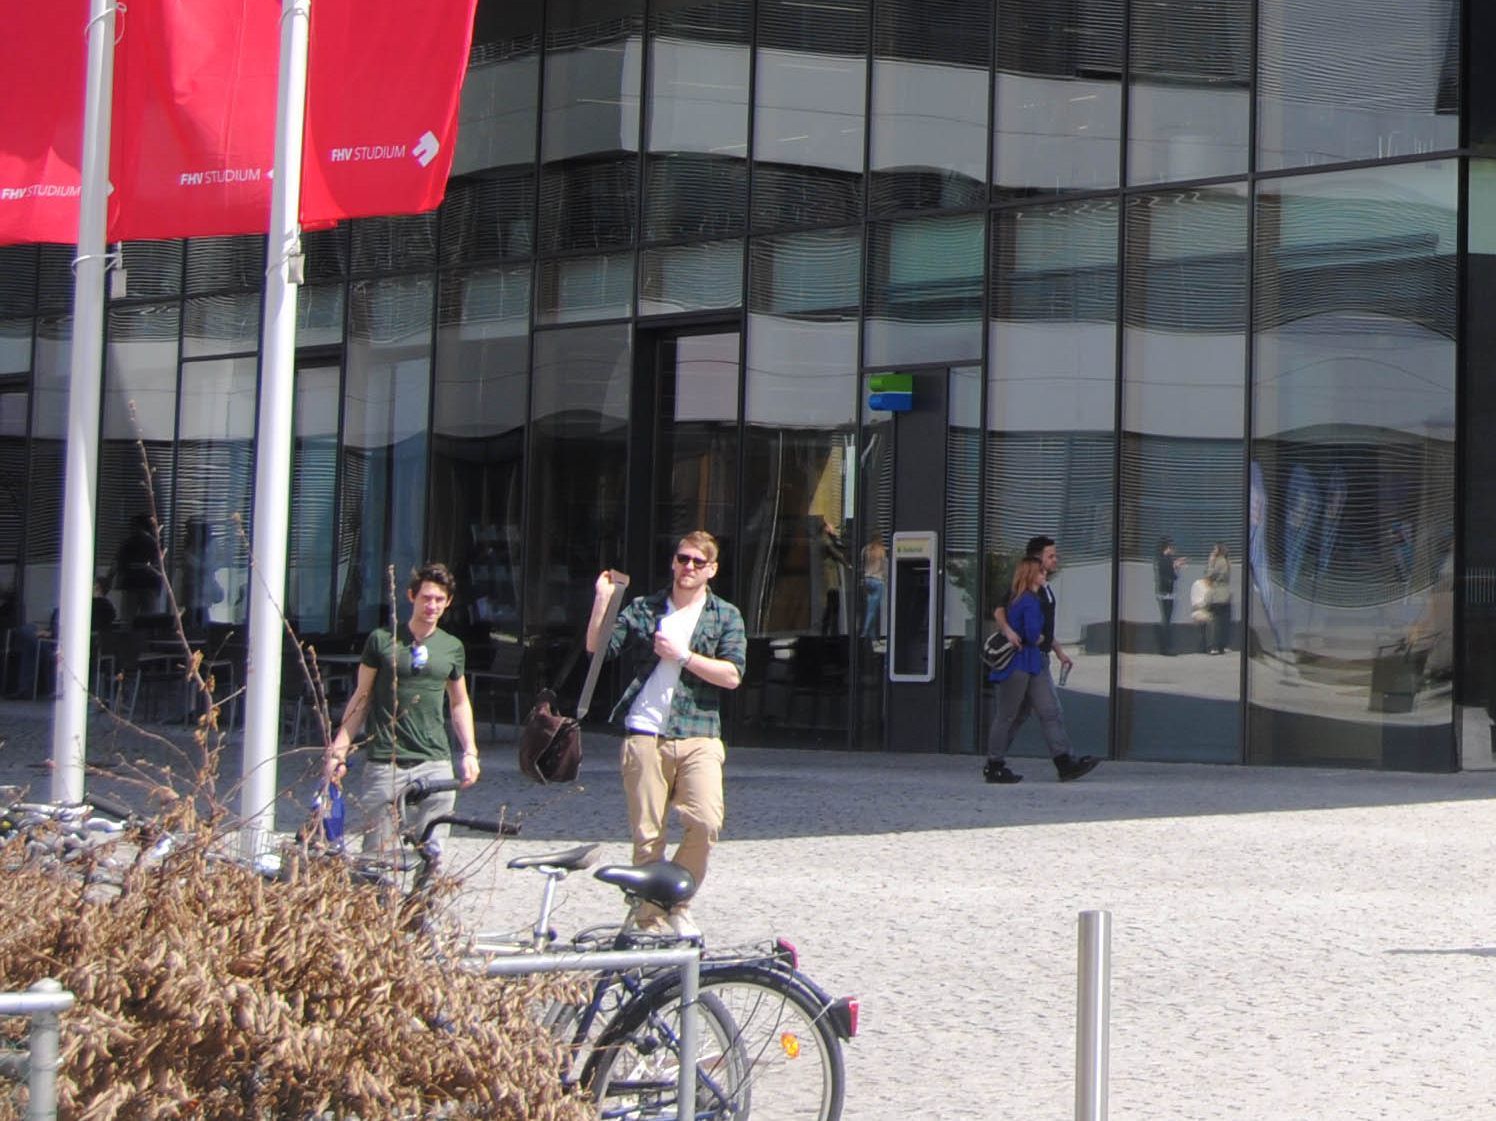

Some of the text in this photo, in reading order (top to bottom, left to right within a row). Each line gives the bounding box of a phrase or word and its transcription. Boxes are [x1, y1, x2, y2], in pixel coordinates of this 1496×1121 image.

[331, 145, 406, 162] FHV STUDIUM
[180, 168, 261, 186] FHV STUDIUM
[2, 184, 81, 199] FHV STUDIUM
